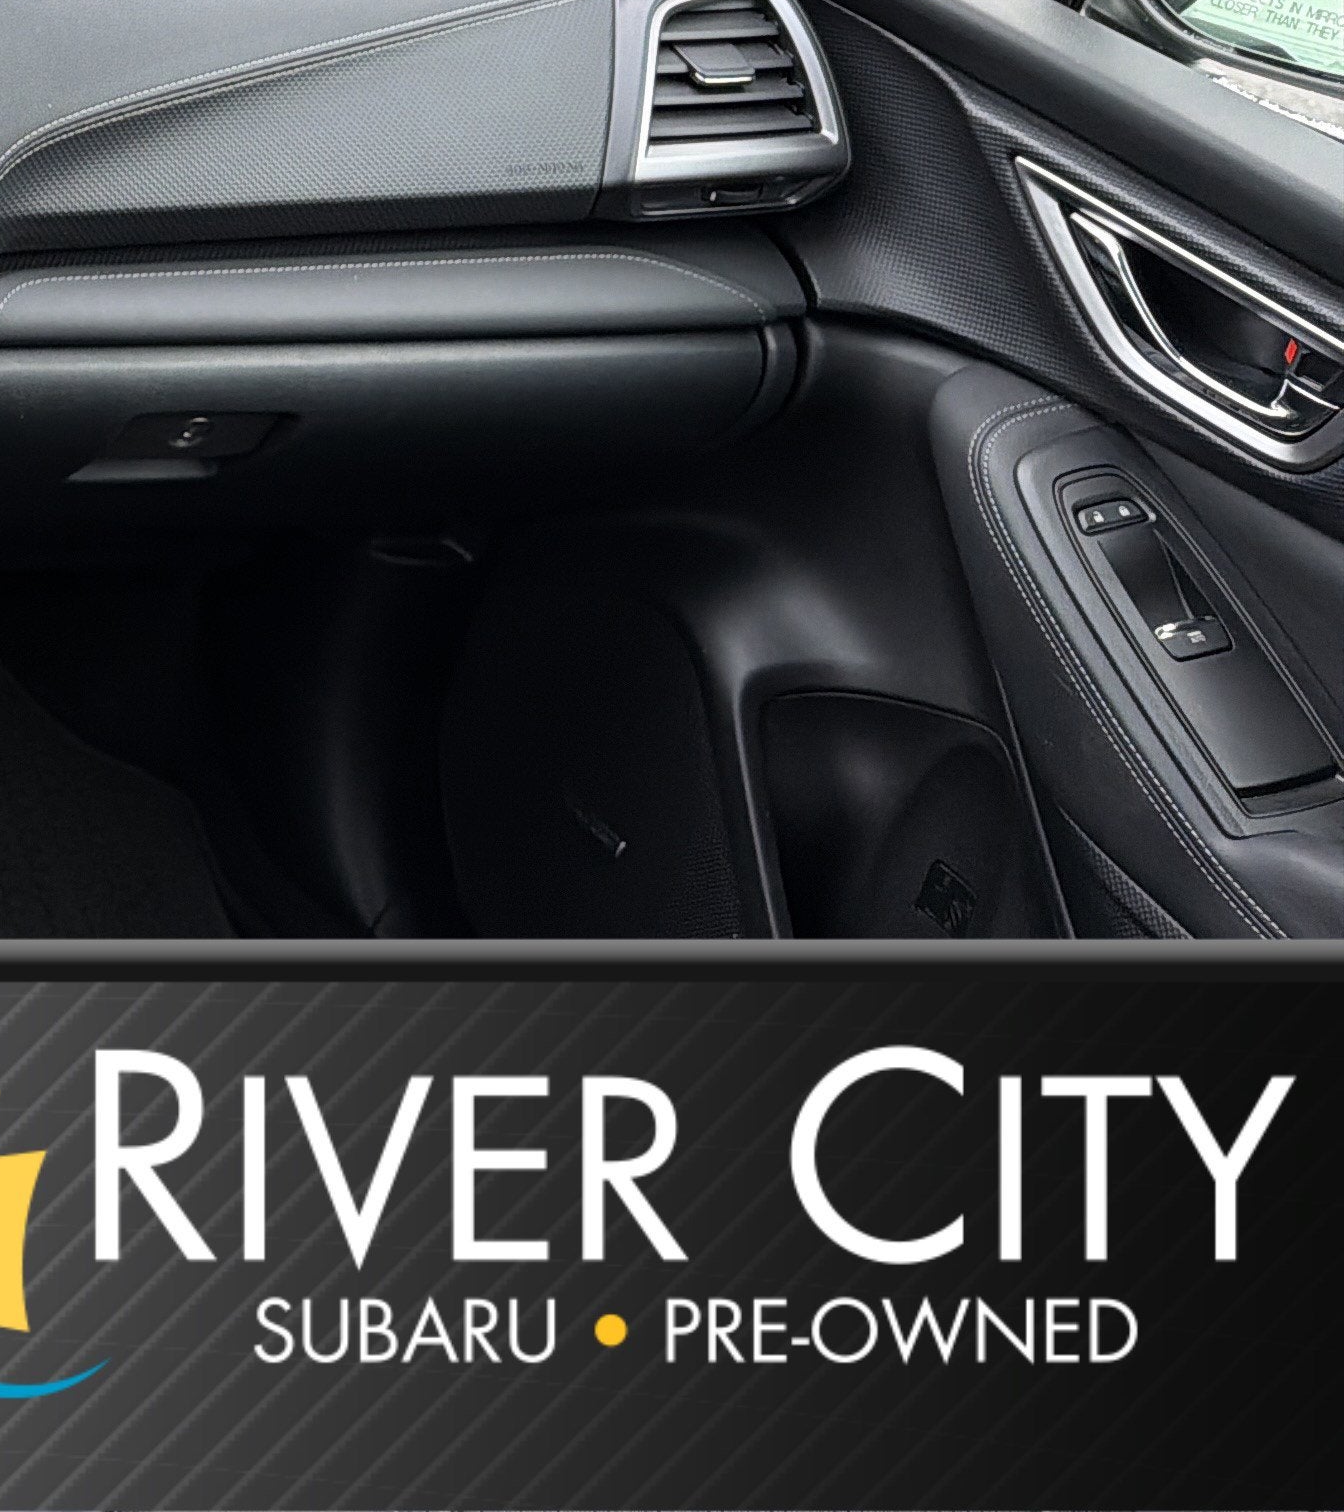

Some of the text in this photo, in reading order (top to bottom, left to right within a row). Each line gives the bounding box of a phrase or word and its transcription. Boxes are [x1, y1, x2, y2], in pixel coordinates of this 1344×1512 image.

[1289, 1, 1304, 15] IN
[1265, 9, 1301, 30] THAN
[1307, 21, 1341, 40] THEY
